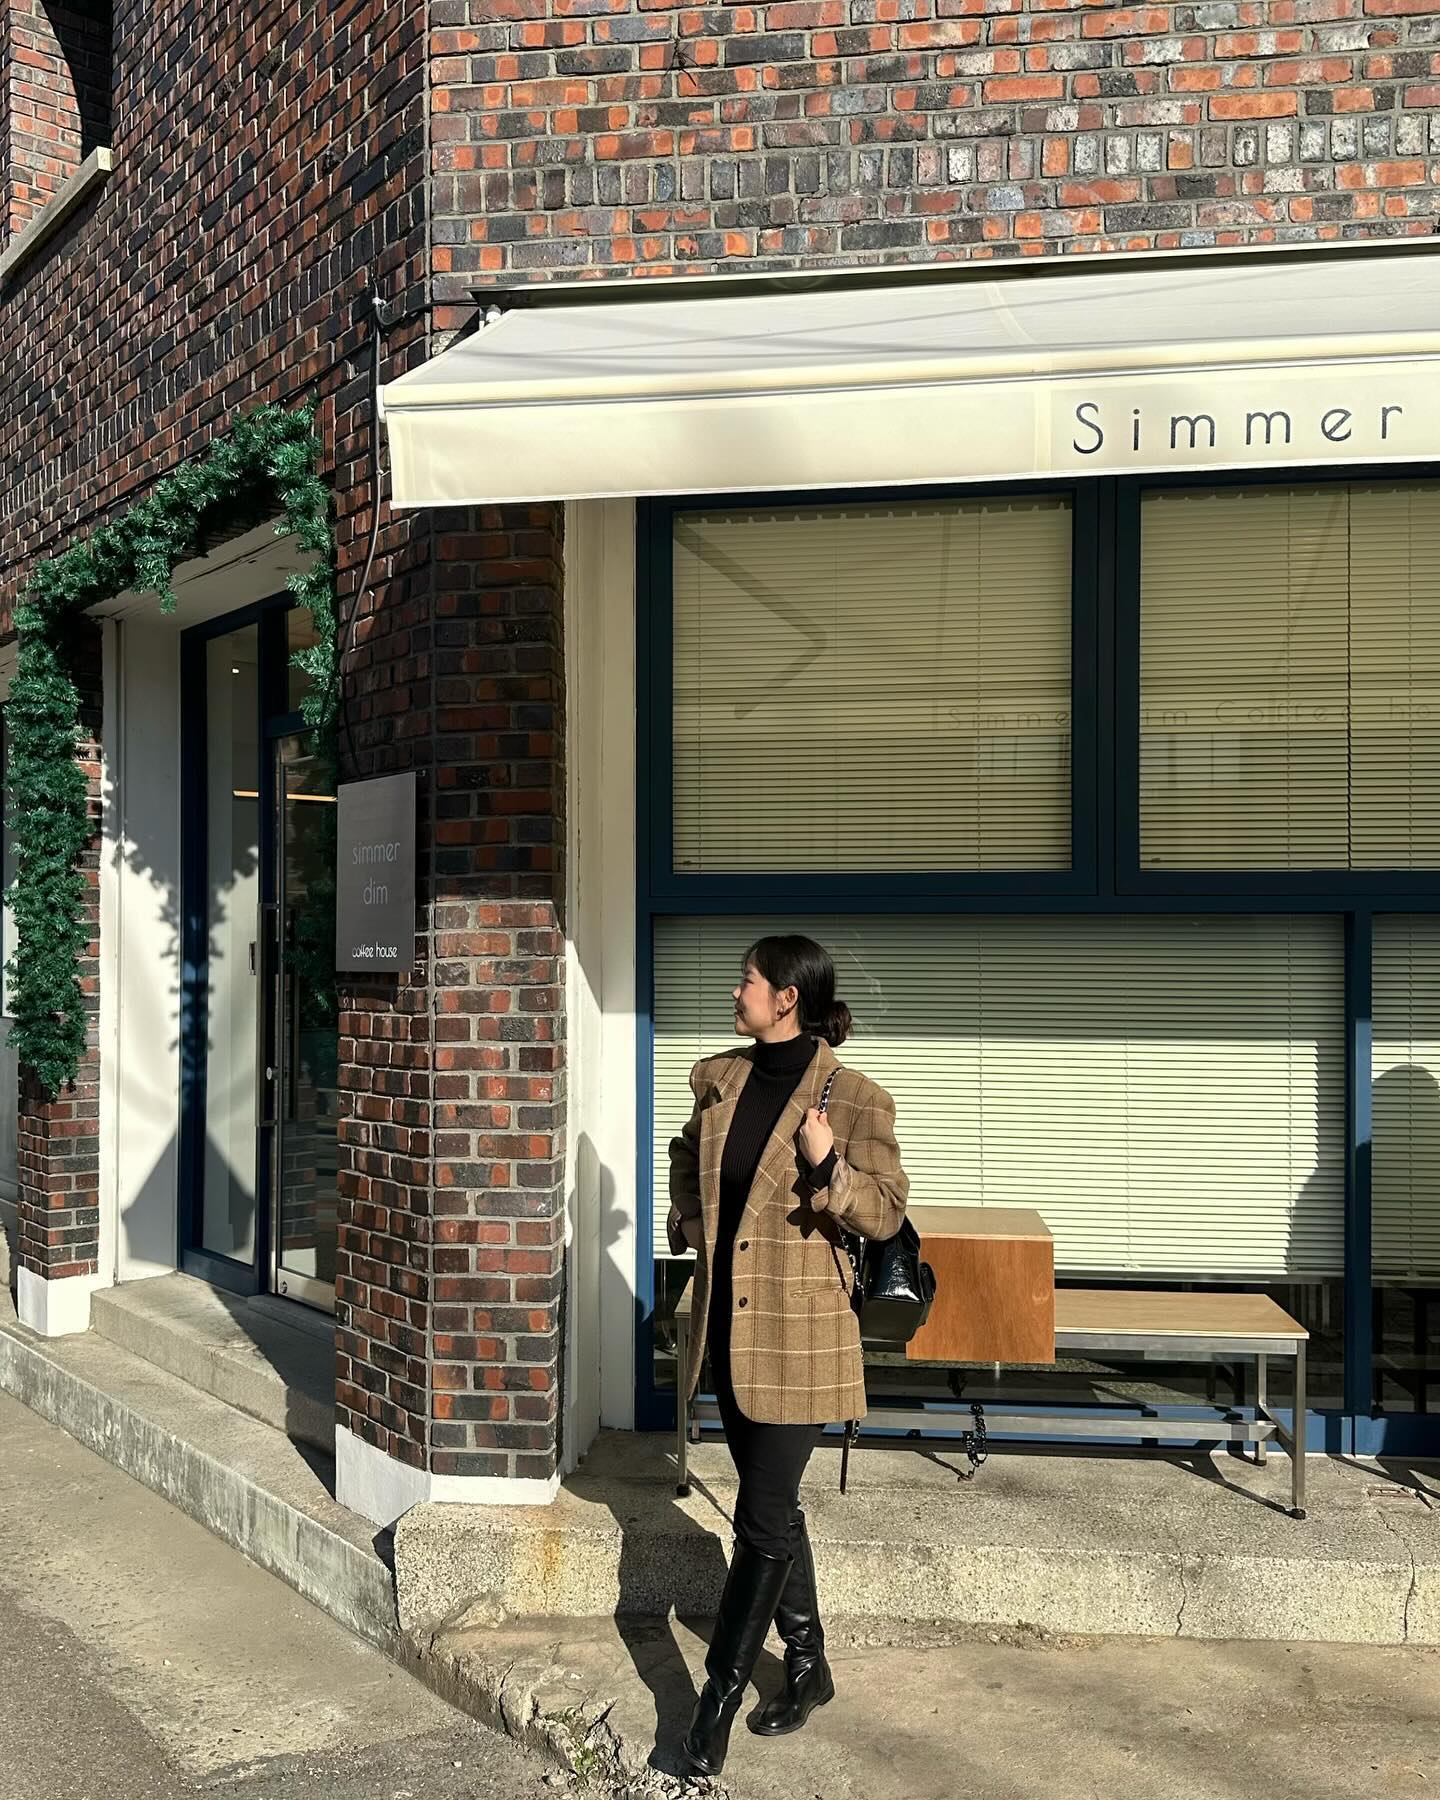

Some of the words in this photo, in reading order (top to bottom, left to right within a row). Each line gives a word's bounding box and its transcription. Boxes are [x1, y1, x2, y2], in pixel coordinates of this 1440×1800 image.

[1073, 402, 1403, 455] Simmer
[949, 708, 1071, 729] Simme
[1140, 705, 1189, 726] im
[352, 842, 400, 864] simmer
[363, 877, 388, 905] dim
[352, 944, 374, 958] coffee
[376, 942, 398, 958] house
